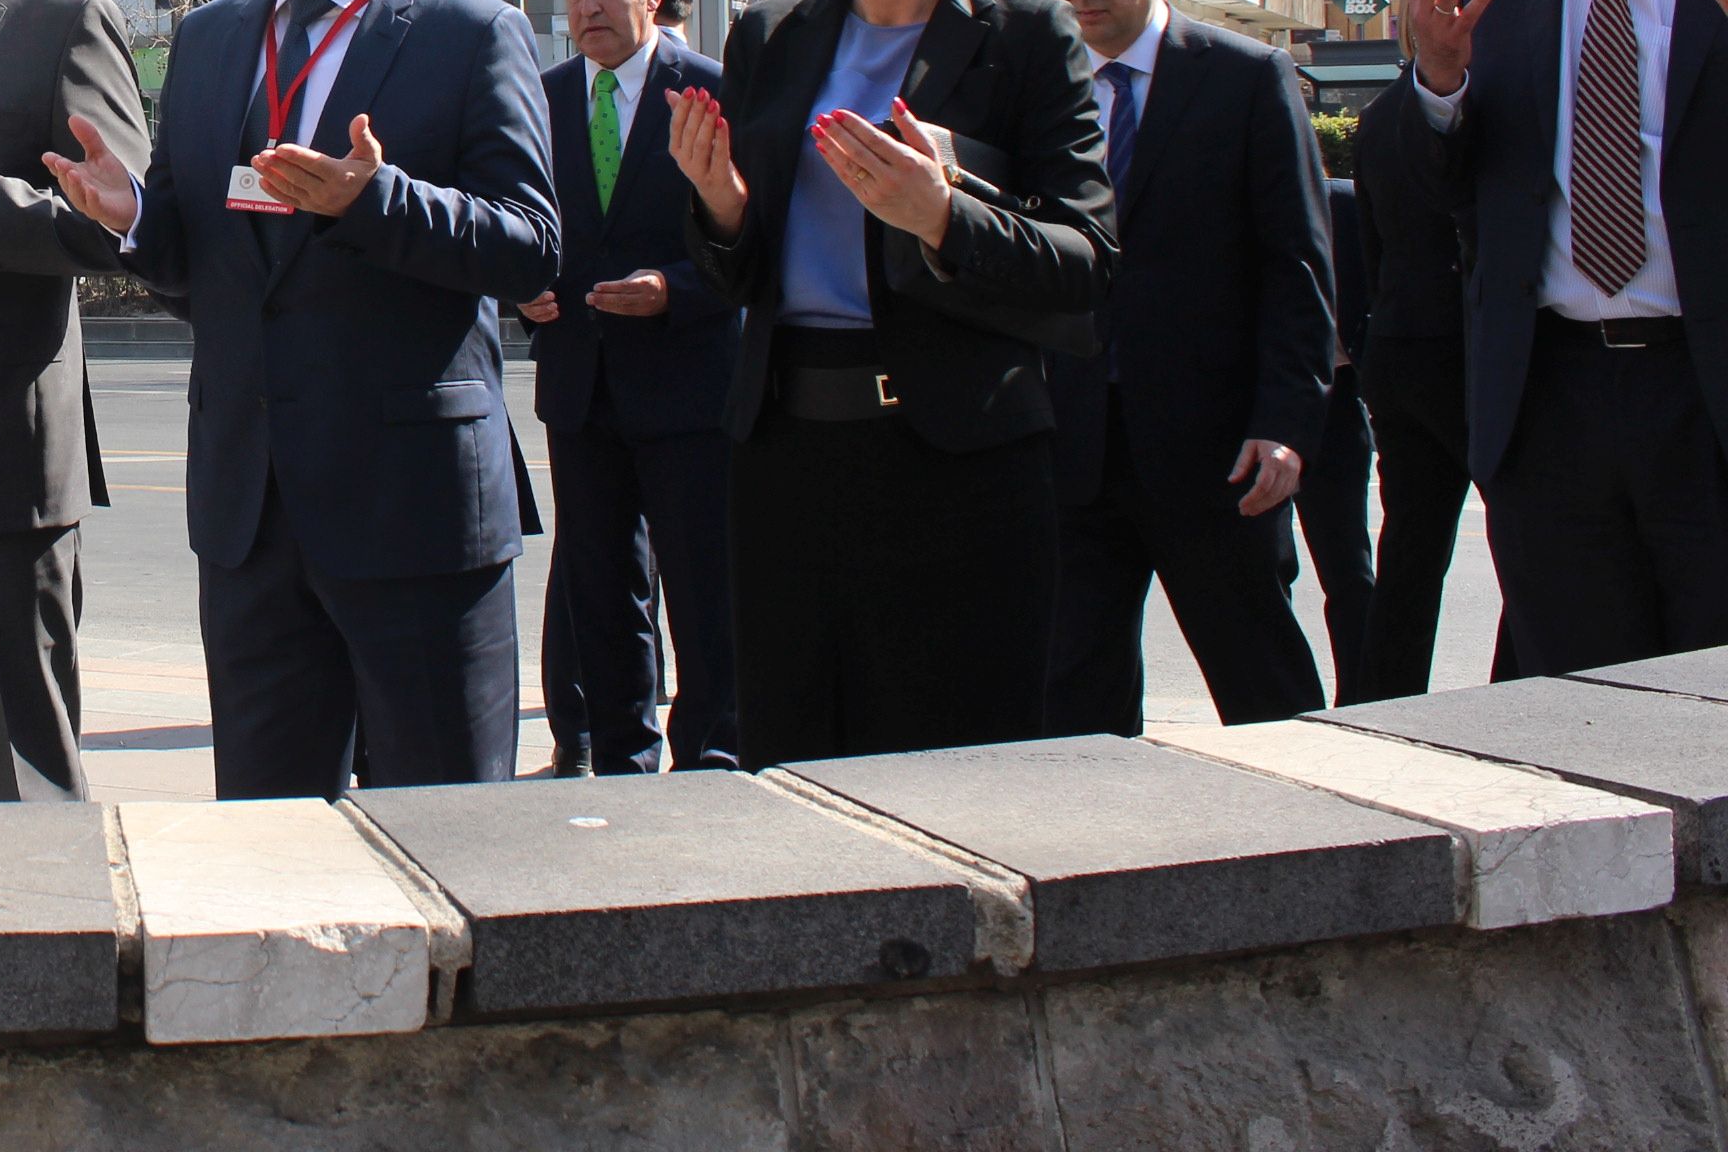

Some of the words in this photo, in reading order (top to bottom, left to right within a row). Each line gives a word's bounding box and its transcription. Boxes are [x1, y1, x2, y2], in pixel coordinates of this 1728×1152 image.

[1345, 4, 1377, 14] BOX
[230, 201, 254, 210] OFFICIAL
[255, 203, 289, 212] DELEGATION
